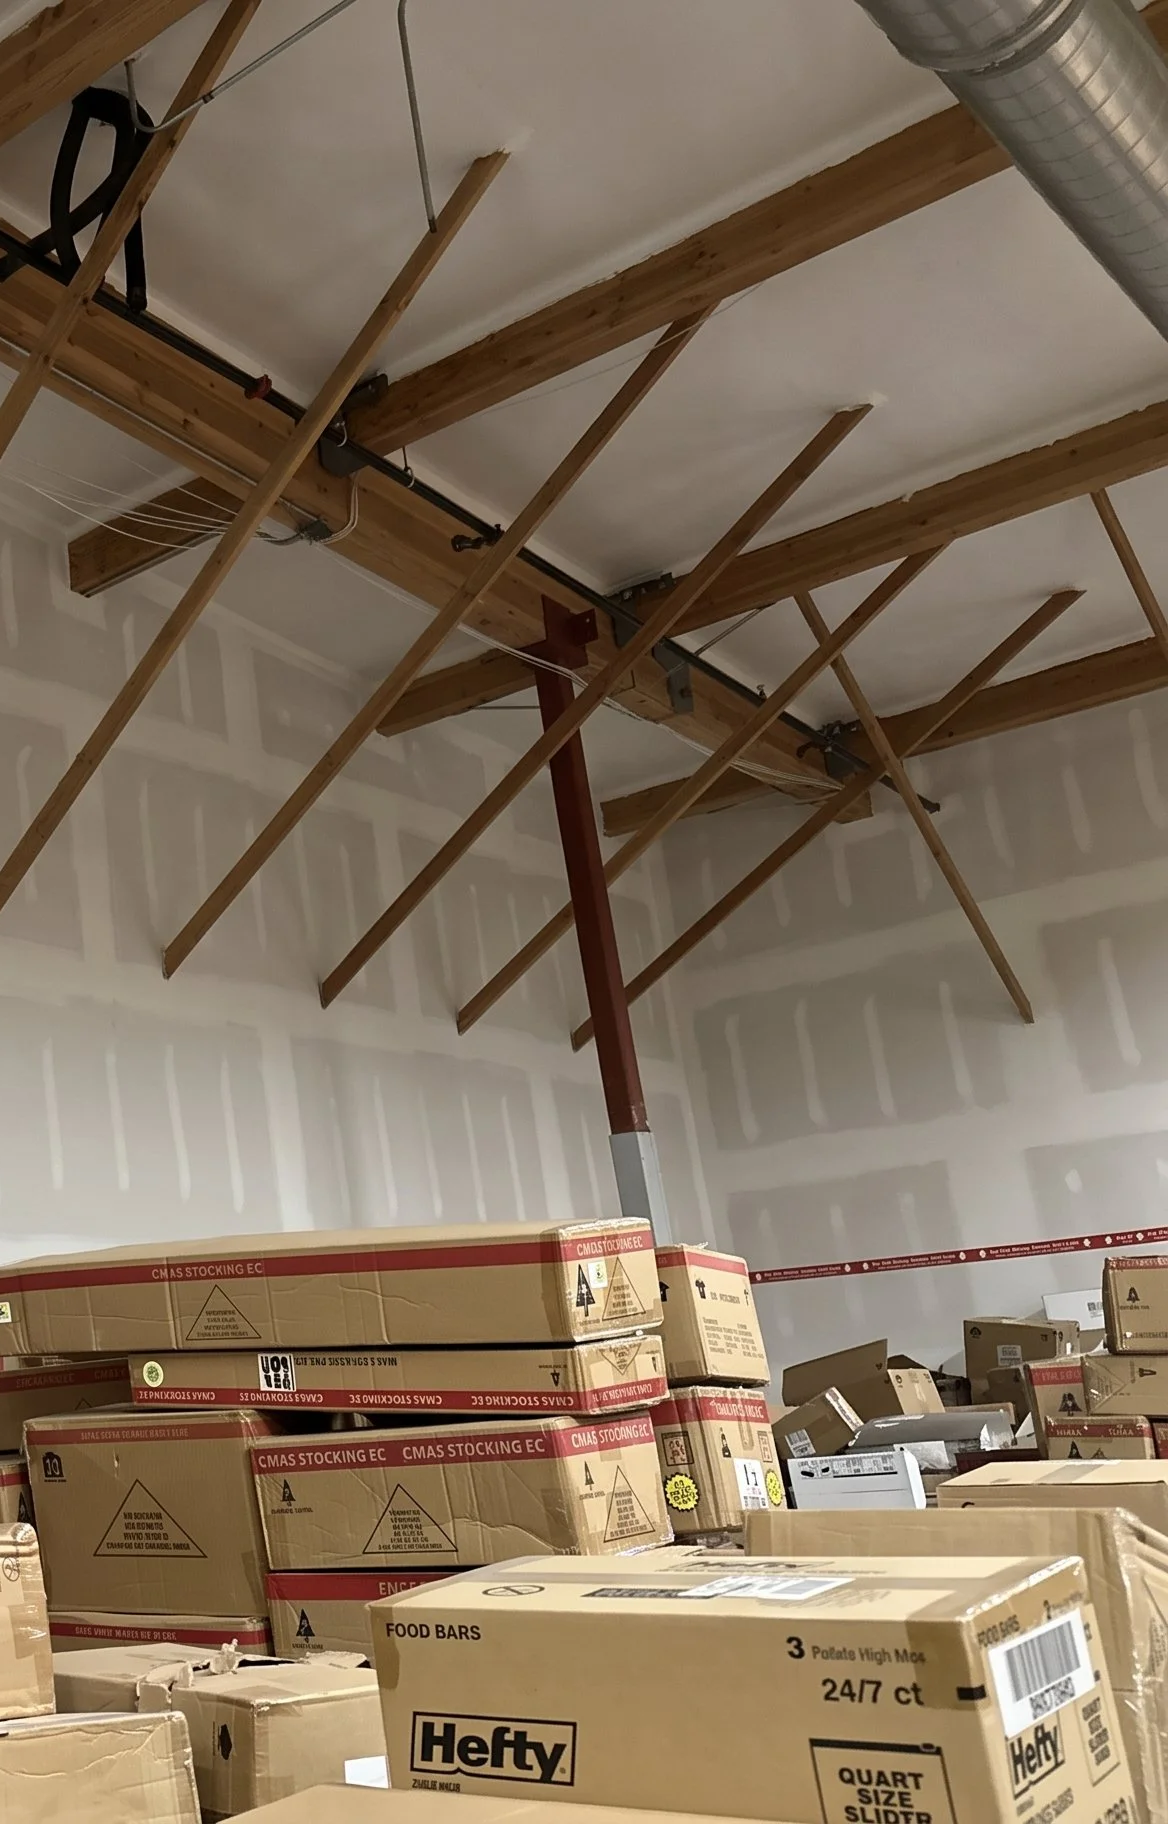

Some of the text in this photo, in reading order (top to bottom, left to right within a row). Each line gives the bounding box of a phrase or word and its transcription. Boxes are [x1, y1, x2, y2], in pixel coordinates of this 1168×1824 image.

[152, 1262, 264, 1280] CMAS STOCKING EC
[258, 1438, 545, 1468] CMAS STOCKING EC CMAS STOCKING EC
[386, 1622, 482, 1640] FOOD BARS
[786, 1636, 805, 1659] 3
[822, 1678, 924, 1706] 24/7 ct
[420, 1720, 567, 1784] Hefty
[1010, 1723, 1058, 1786] Hefty
[838, 1767, 924, 1790] QUART
[857, 1788, 914, 1809] SIZE
